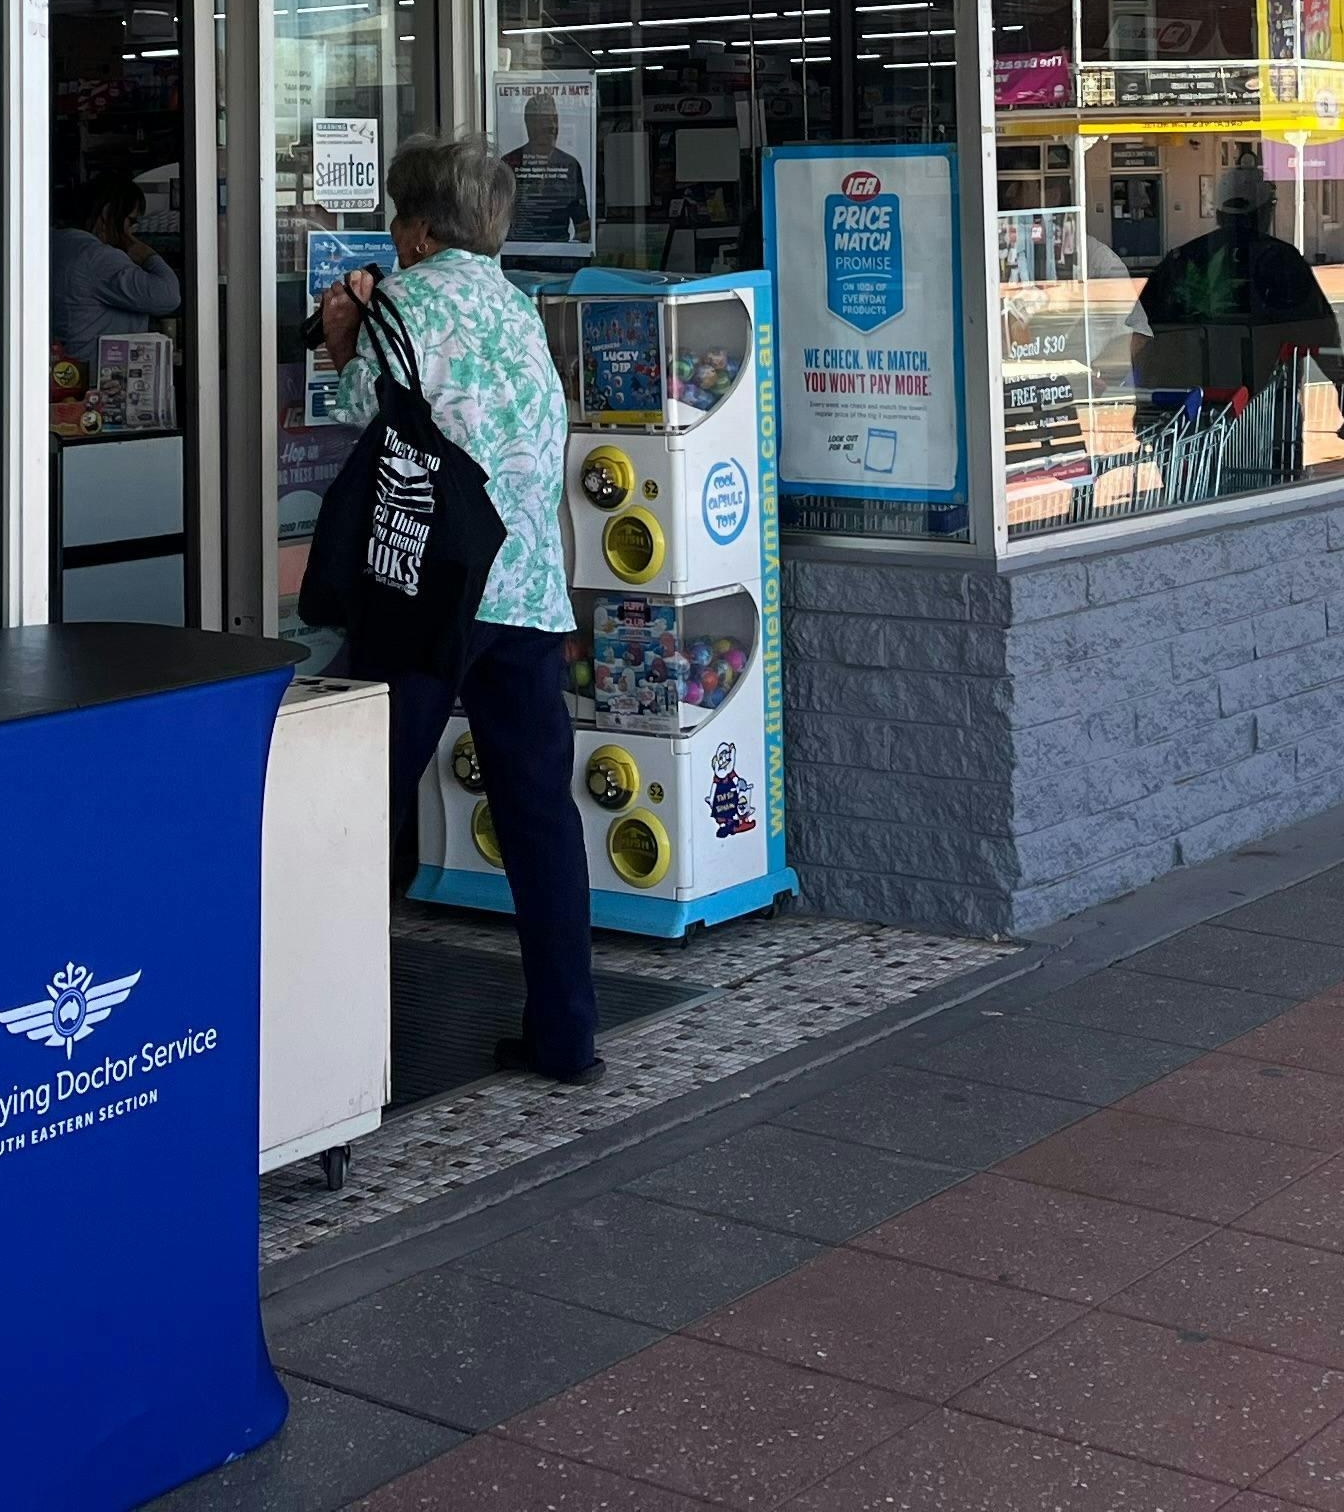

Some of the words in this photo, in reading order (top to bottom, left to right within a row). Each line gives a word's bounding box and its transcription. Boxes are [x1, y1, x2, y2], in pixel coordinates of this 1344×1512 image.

[499, 86, 520, 97] LET'S
[522, 86, 542, 96] HELP
[544, 86, 559, 96] OUT
[561, 86, 568, 96] A
[569, 85, 589, 96] MATE
[316, 153, 374, 187] simtec
[845, 176, 877, 196] IGA
[832, 205, 893, 230] PRICE
[834, 231, 891, 252] MATCH
[835, 256, 892, 271] PROMISE
[842, 283, 854, 292] ON
[876, 282, 887, 293] OF
[842, 293, 886, 305] EVERYDAY
[842, 305, 887, 315] PRODUCTS
[602, 350, 639, 362] LUCKY
[1011, 336, 1040, 362] Spend
[611, 362, 631, 374] DIP
[804, 348, 822, 369] WE
[824, 349, 864, 370] CHECK.
[867, 349, 885, 370] WE
[887, 349, 931, 372] MATCH.
[804, 372, 826, 393] YOU
[828, 372, 866, 395] WON'T
[870, 373, 892, 395] PAY
[1011, 385, 1037, 407] FREE
[828, 435, 844, 443] LOOK
[280, 443, 306, 466] Hop
[290, 466, 313, 484] THESE
[714, 472, 736, 489] COOL
[708, 490, 744, 510] CAPSULE
[391, 510, 430, 542] thing
[716, 513, 738, 530] TOYS
[389, 531, 425, 559] many
[759, 324, 784, 837] www.timthetoyman.com.au
[649, 783, 664, 800] $2
[56, 1056, 139, 1102] Doctor
[141, 1025, 219, 1073] Service
[30, 1112, 95, 1151] EASTERN
[98, 1089, 159, 1132] SECTION
